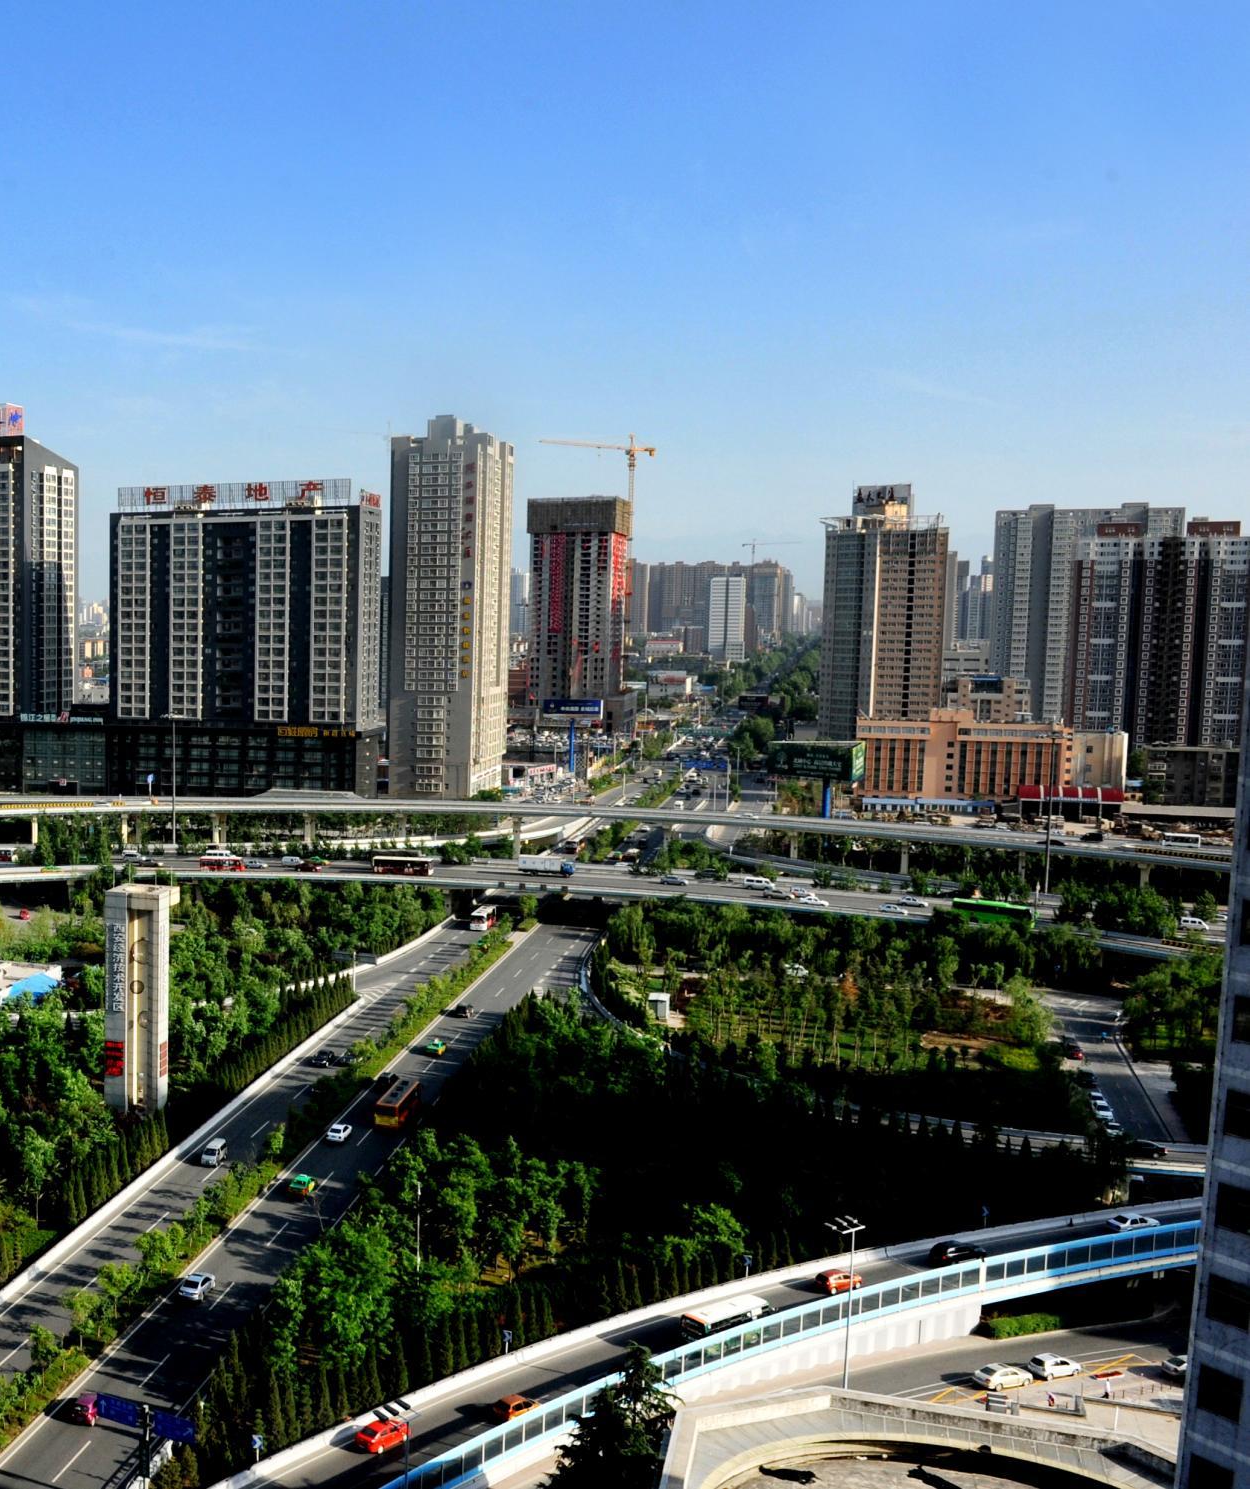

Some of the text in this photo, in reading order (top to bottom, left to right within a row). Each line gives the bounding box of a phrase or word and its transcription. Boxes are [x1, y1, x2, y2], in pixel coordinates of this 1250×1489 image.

[144, 481, 323, 505] 恒泰地产
[112, 923, 125, 1012] 西安经济技术开发区
